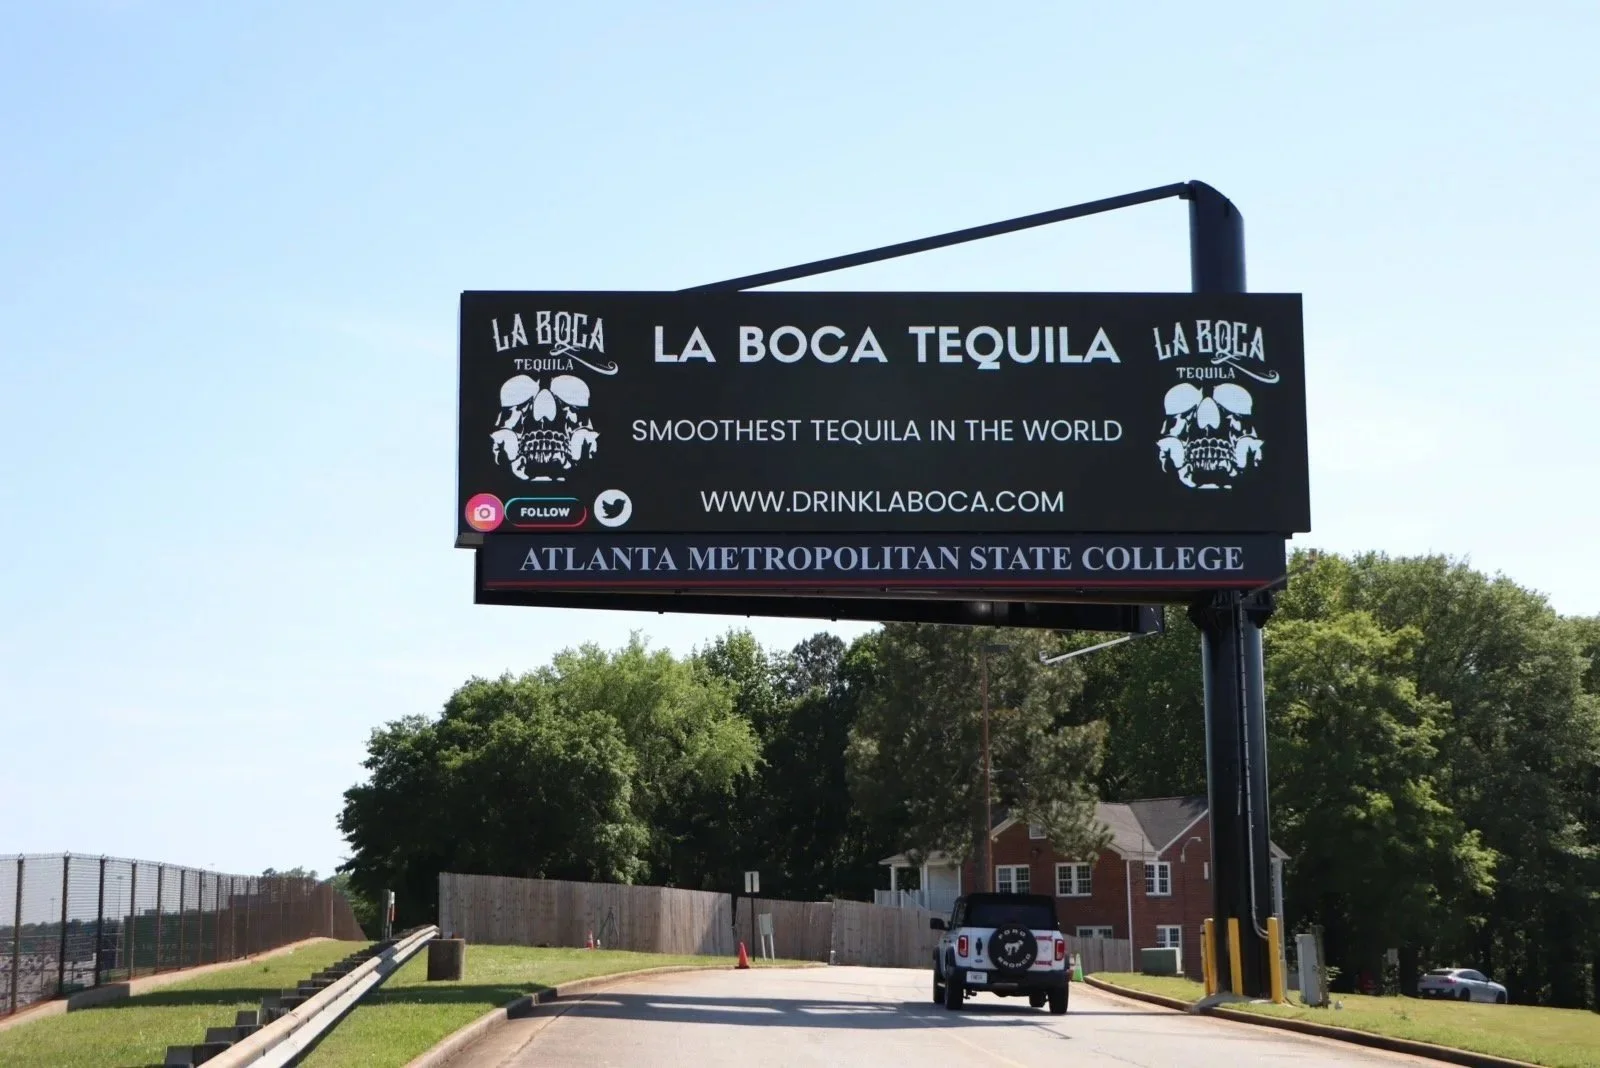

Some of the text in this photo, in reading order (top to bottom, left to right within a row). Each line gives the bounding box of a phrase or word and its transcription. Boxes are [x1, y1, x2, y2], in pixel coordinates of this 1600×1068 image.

[491, 311, 606, 356] LA BOCA
[1152, 319, 1266, 364] LA BOCA
[654, 325, 1121, 370] LA BOCA TEQUILA
[513, 358, 574, 372] TEQUILA
[1176, 366, 1236, 380] TEQUILA
[631, 418, 1124, 446] SMOOTHEST TEQUILA IN THE WORLD
[520, 507, 571, 518] FOLLOW
[699, 489, 1065, 514] WWW.DRINKLABOCA.COM
[519, 545, 1245, 571] ATLANTA METROPOLITAN STATE COLLEGE
[998, 928, 1026, 940] FORD
[997, 953, 1032, 968] BRONCO
